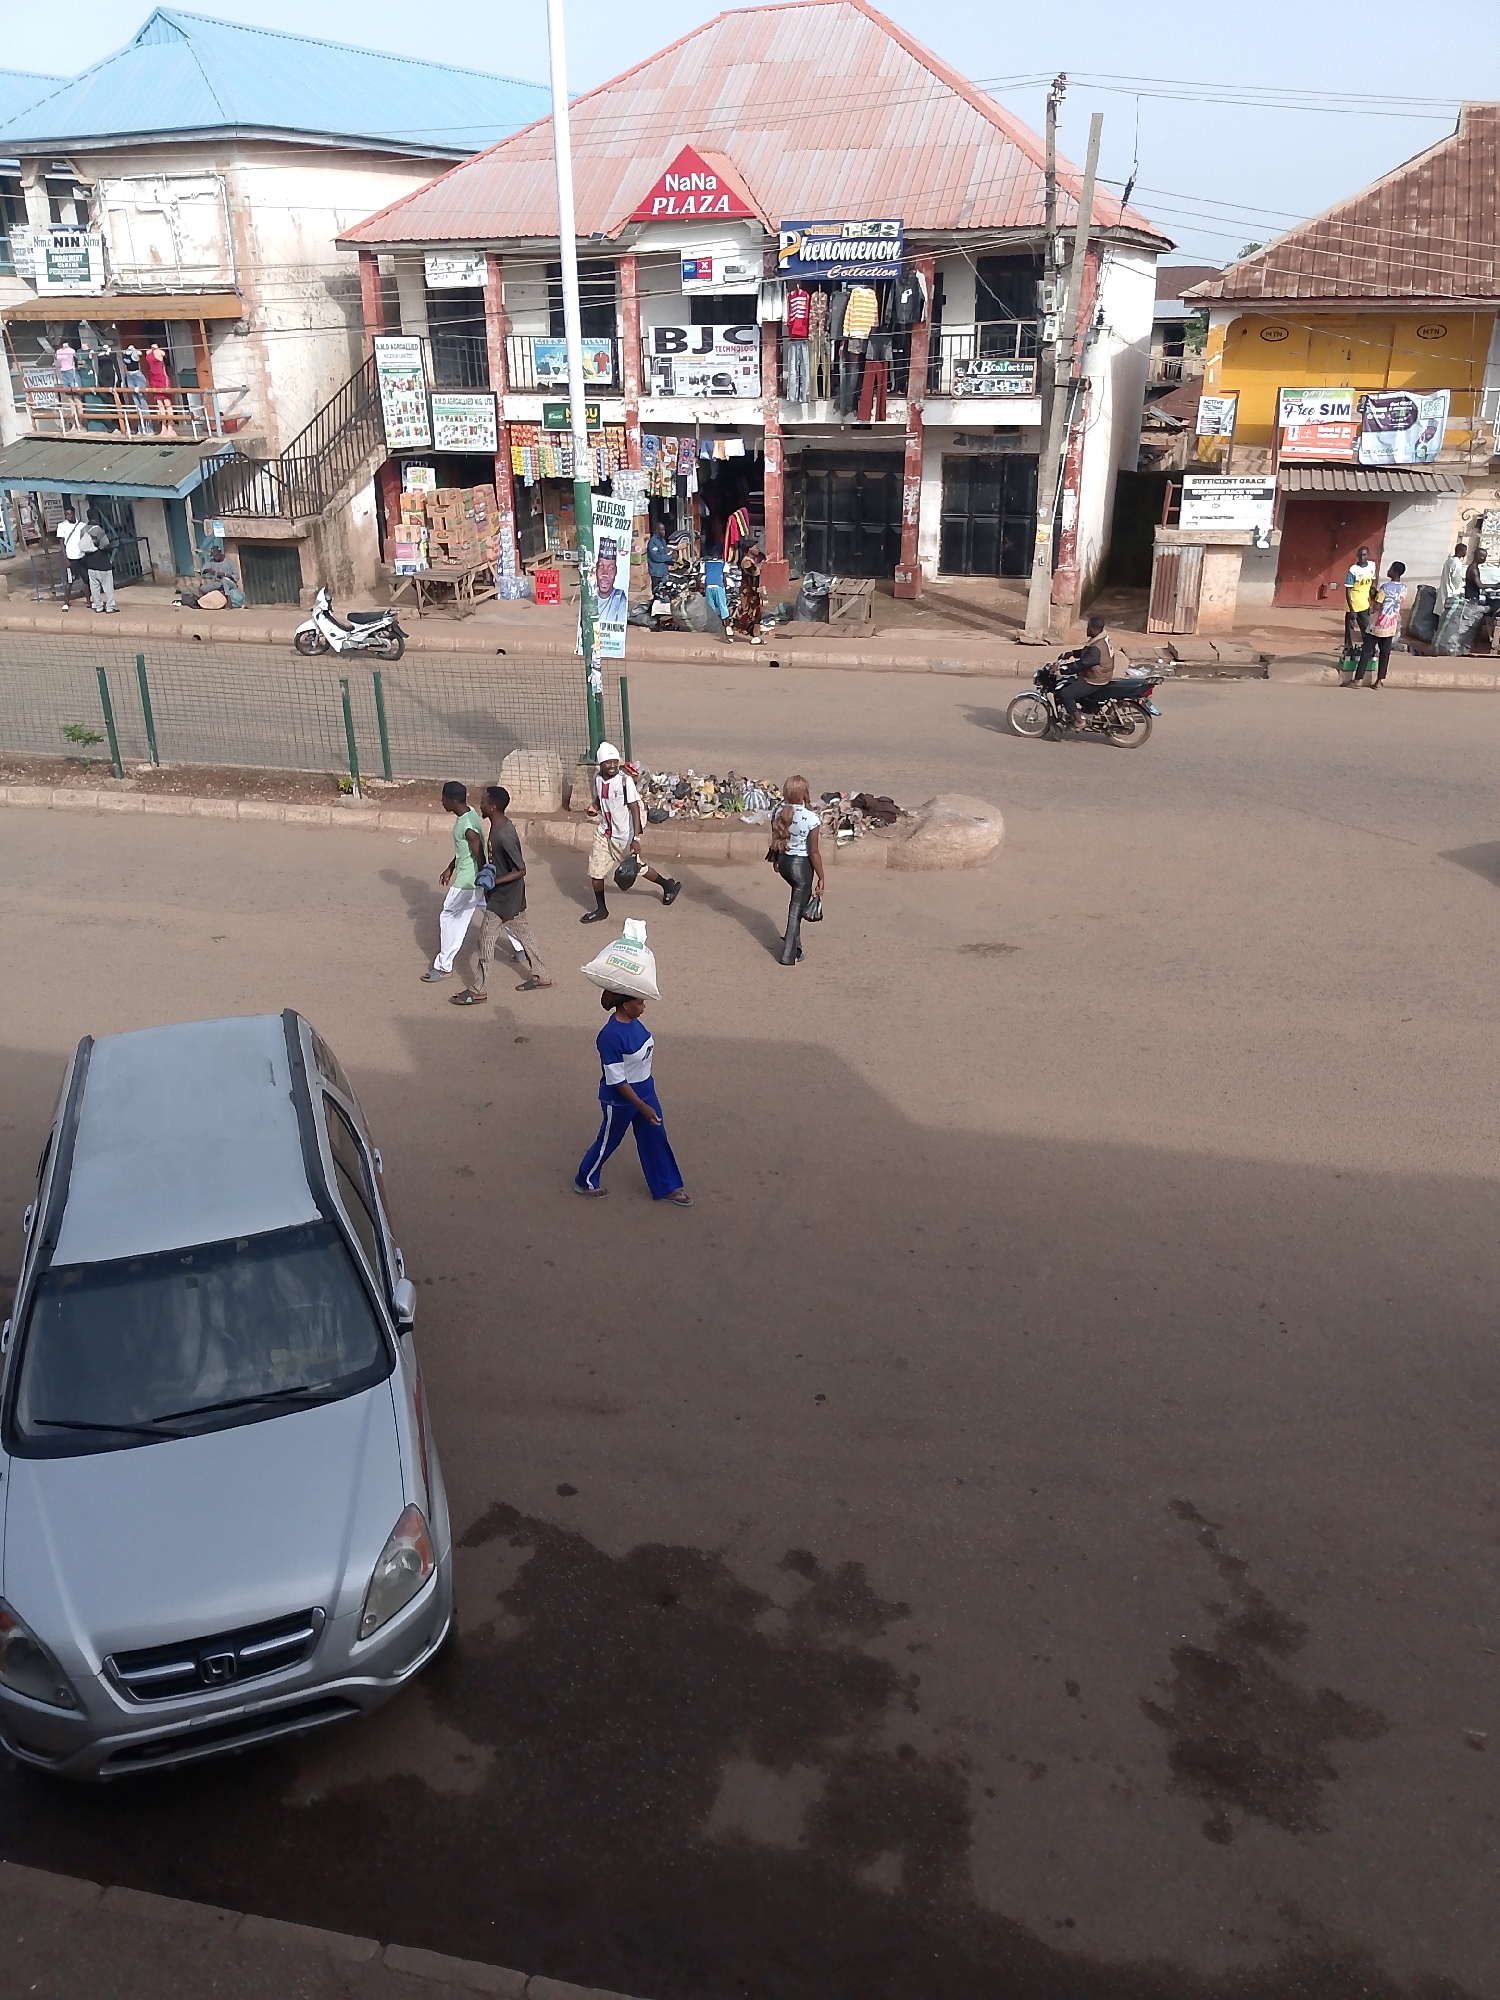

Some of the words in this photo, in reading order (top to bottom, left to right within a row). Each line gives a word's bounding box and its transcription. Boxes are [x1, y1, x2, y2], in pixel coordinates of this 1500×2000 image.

[665, 172, 717, 192] NaNa
[651, 194, 731, 216] PLAZA
[53, 236, 80, 247] NIN
[778, 231, 901, 269] Phenomenon
[826, 265, 899, 279] Collection
[654, 325, 754, 355] BJC
[1265, 330, 1283, 338] MTN
[715, 345, 758, 353] TECHNOLOGY
[1284, 402, 1316, 419] Free
[1319, 403, 1351, 416] SIM
[1239, 477, 1267, 485] GRACE
[596, 499, 626, 518] SELFLESS
[592, 512, 614, 529] ERVICE
[614, 517, 632, 532] 2027
